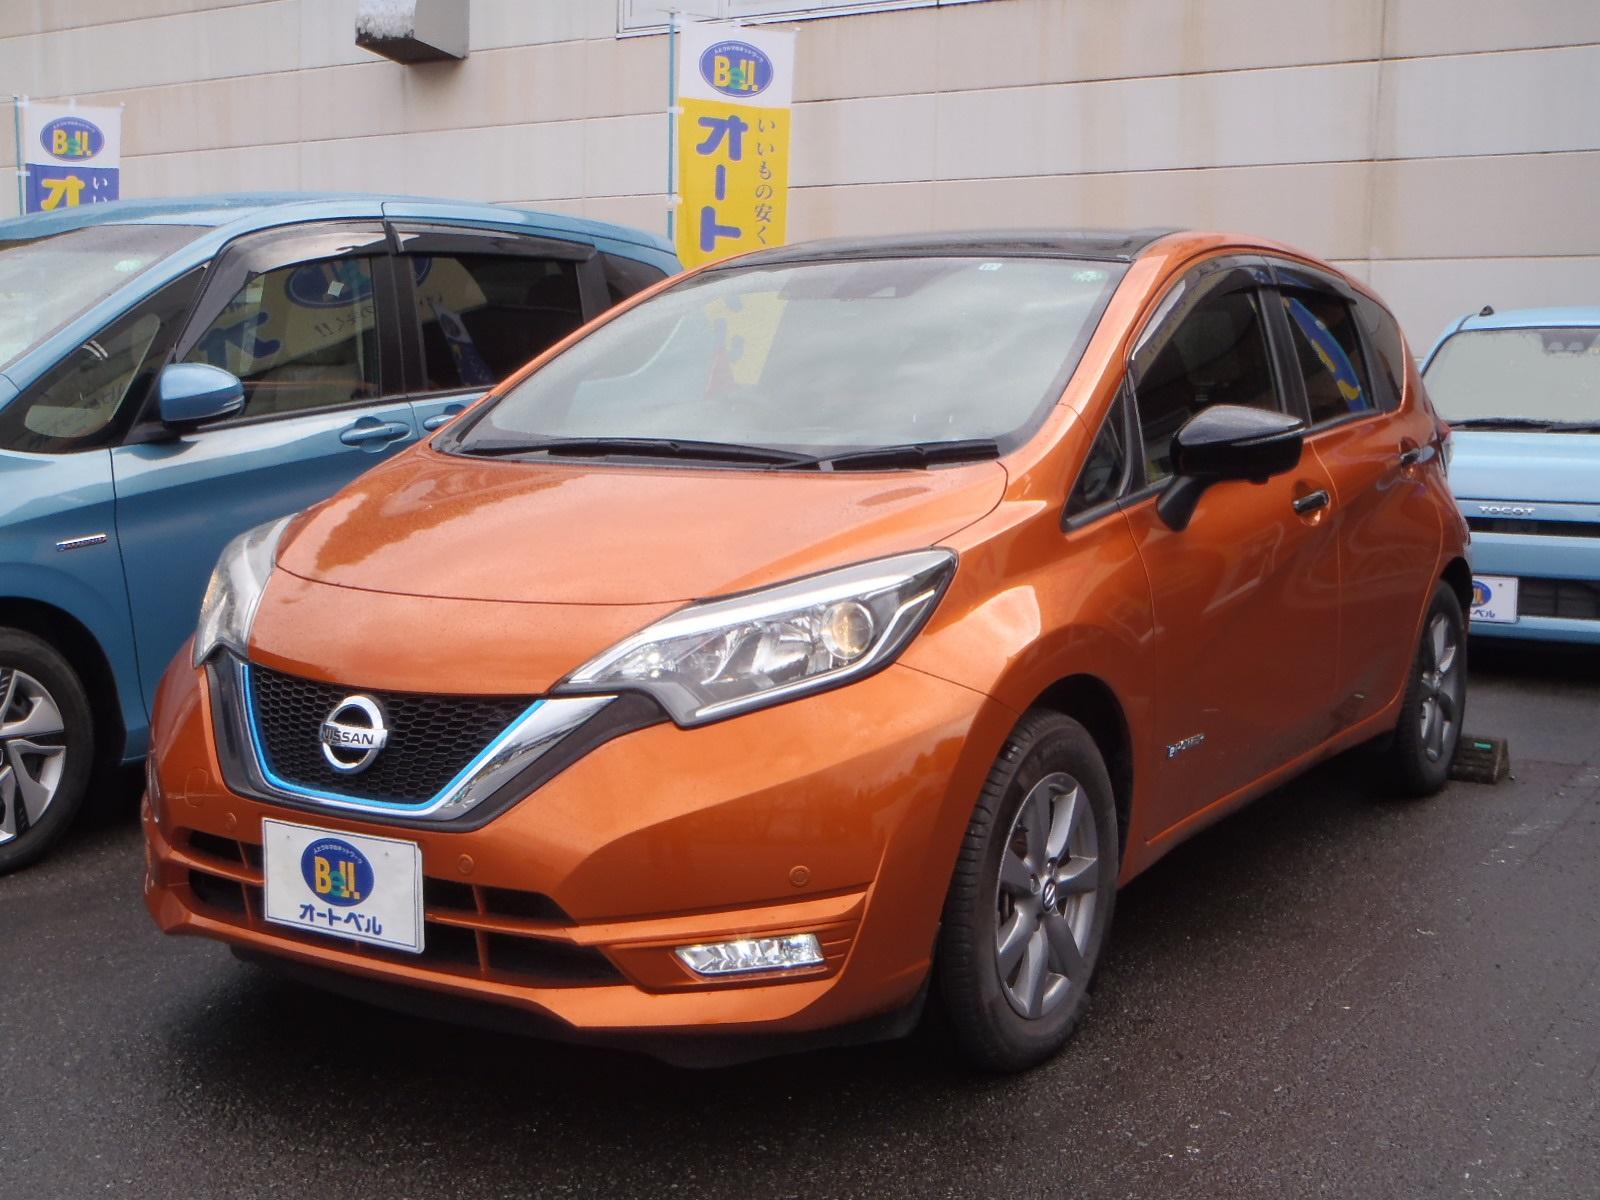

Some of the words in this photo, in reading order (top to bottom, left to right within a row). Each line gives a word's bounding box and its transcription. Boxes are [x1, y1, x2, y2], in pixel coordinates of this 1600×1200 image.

[696, 115, 749, 252] オート
[754, 119, 777, 245] いいもの安く
[1478, 506, 1535, 515] TOCOT
[322, 728, 374, 745] NISSAN
[299, 904, 382, 935] オートベル
